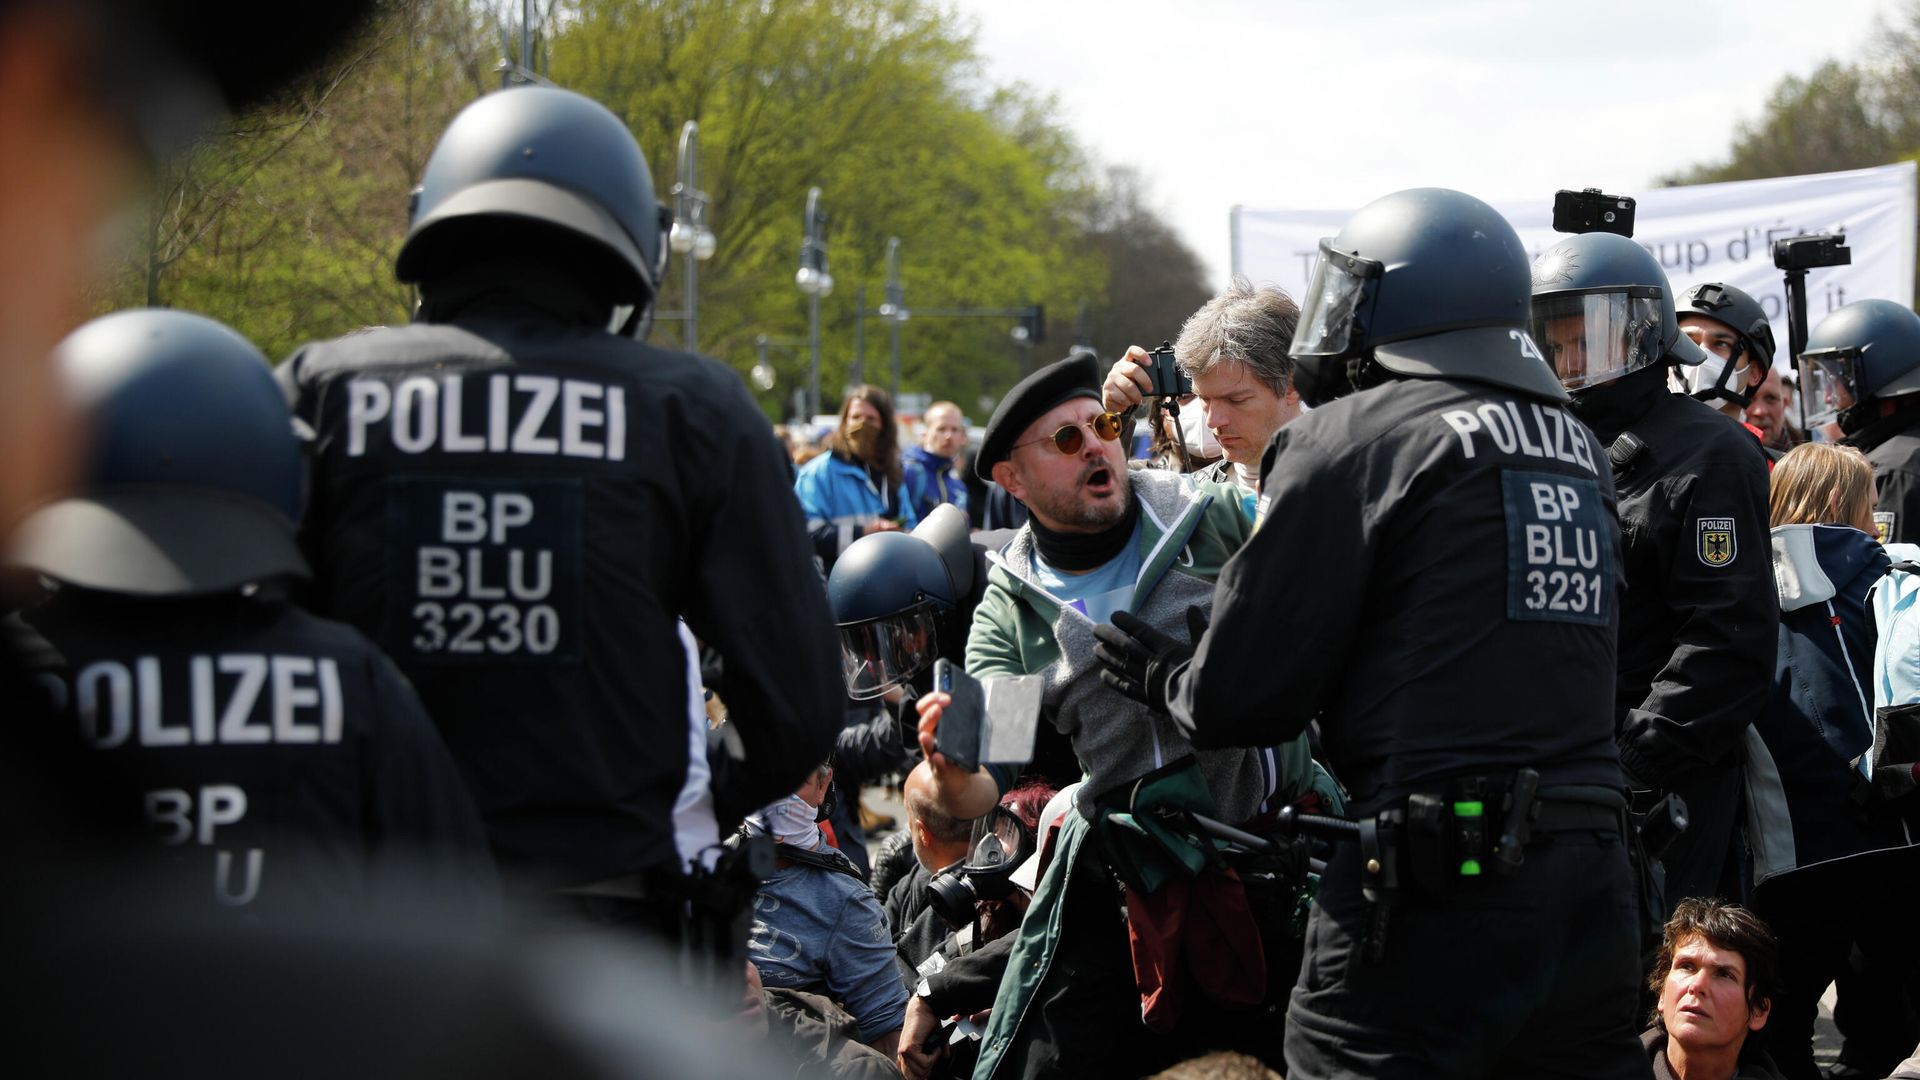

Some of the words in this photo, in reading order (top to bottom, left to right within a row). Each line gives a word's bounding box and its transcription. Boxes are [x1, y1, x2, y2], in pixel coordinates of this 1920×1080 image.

[1646, 241, 1709, 275] up
[346, 374, 627, 461] POLIZEI
[1441, 400, 1599, 476] POLIZEI
[442, 491, 534, 544] BP
[1530, 482, 1580, 522] BP
[1701, 520, 1732, 531] POLIZEI
[1526, 524, 1598, 569] BLU
[418, 547, 552, 600] BLU
[1525, 570, 1601, 614] 3231
[412, 602, 560, 653] 3230
[144, 784, 248, 846] BP
